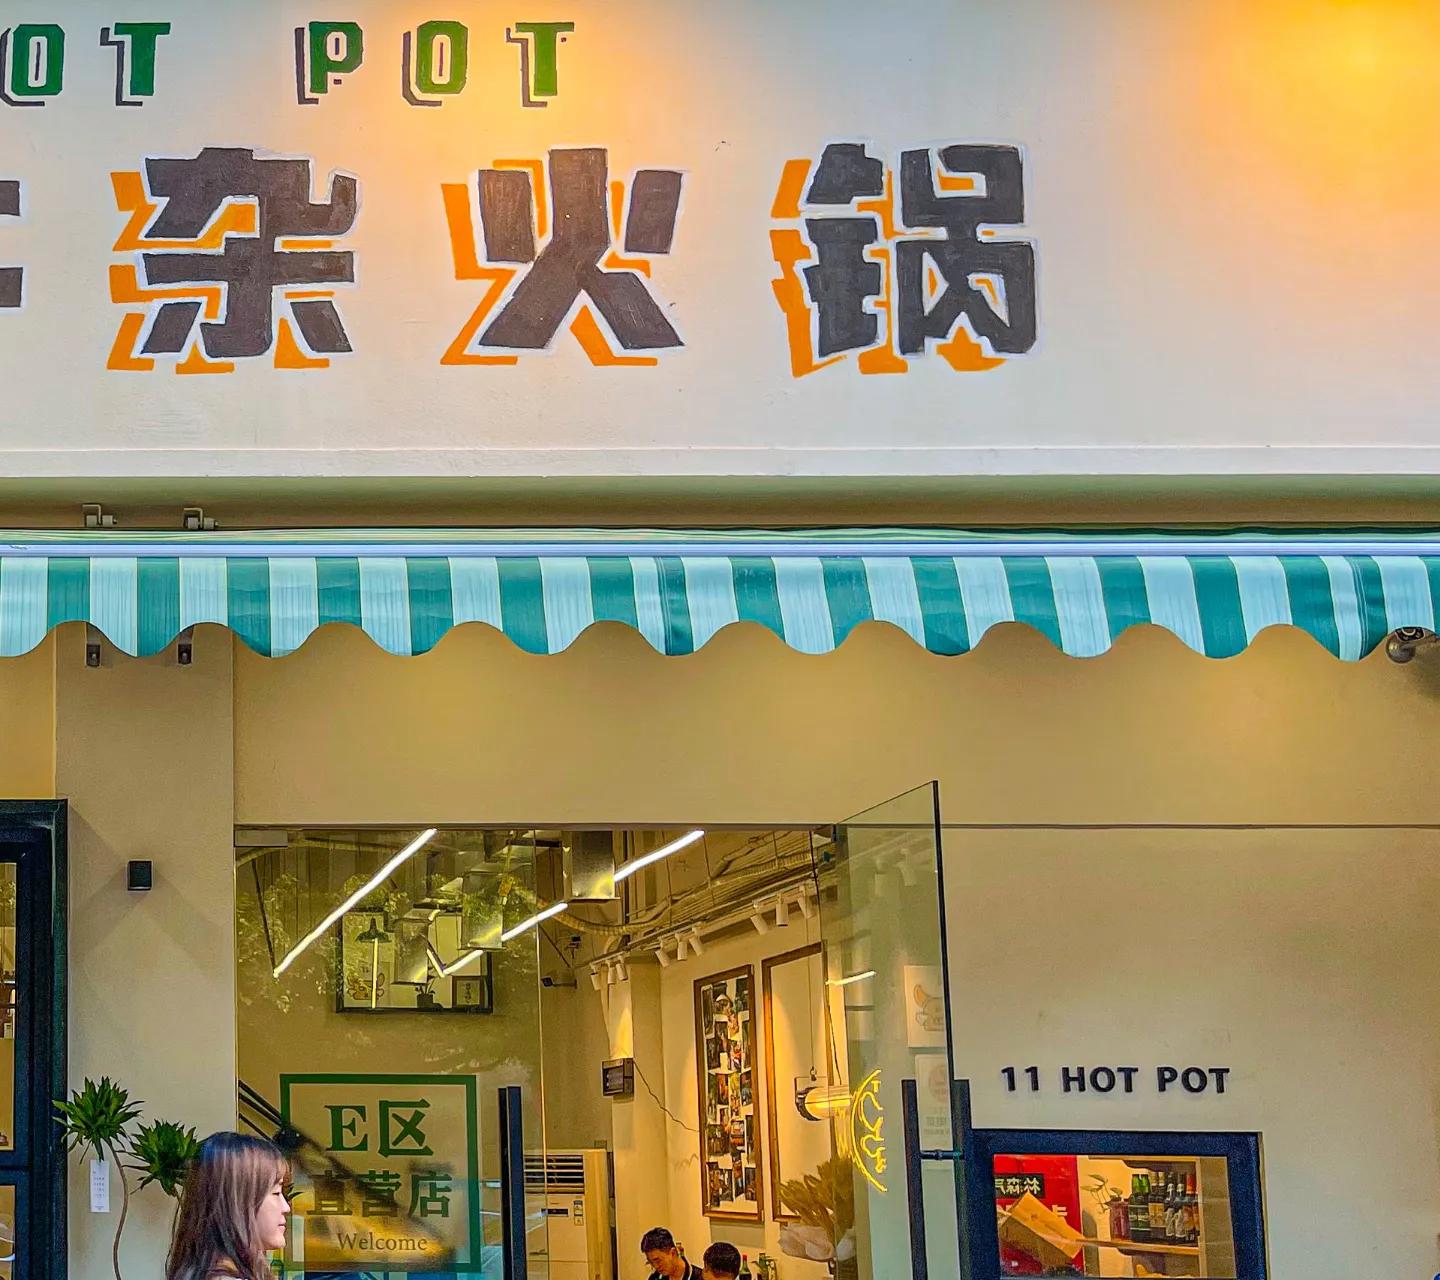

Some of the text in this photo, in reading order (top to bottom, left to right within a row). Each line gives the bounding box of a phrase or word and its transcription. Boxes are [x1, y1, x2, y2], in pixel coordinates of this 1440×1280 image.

[296, 21, 575, 106] POT
[1001, 1066, 1230, 1094] 11 HOT POT
[324, 1098, 434, 1158] E区
[306, 1169, 453, 1218] 直营店
[336, 1231, 428, 1251] Welcome
